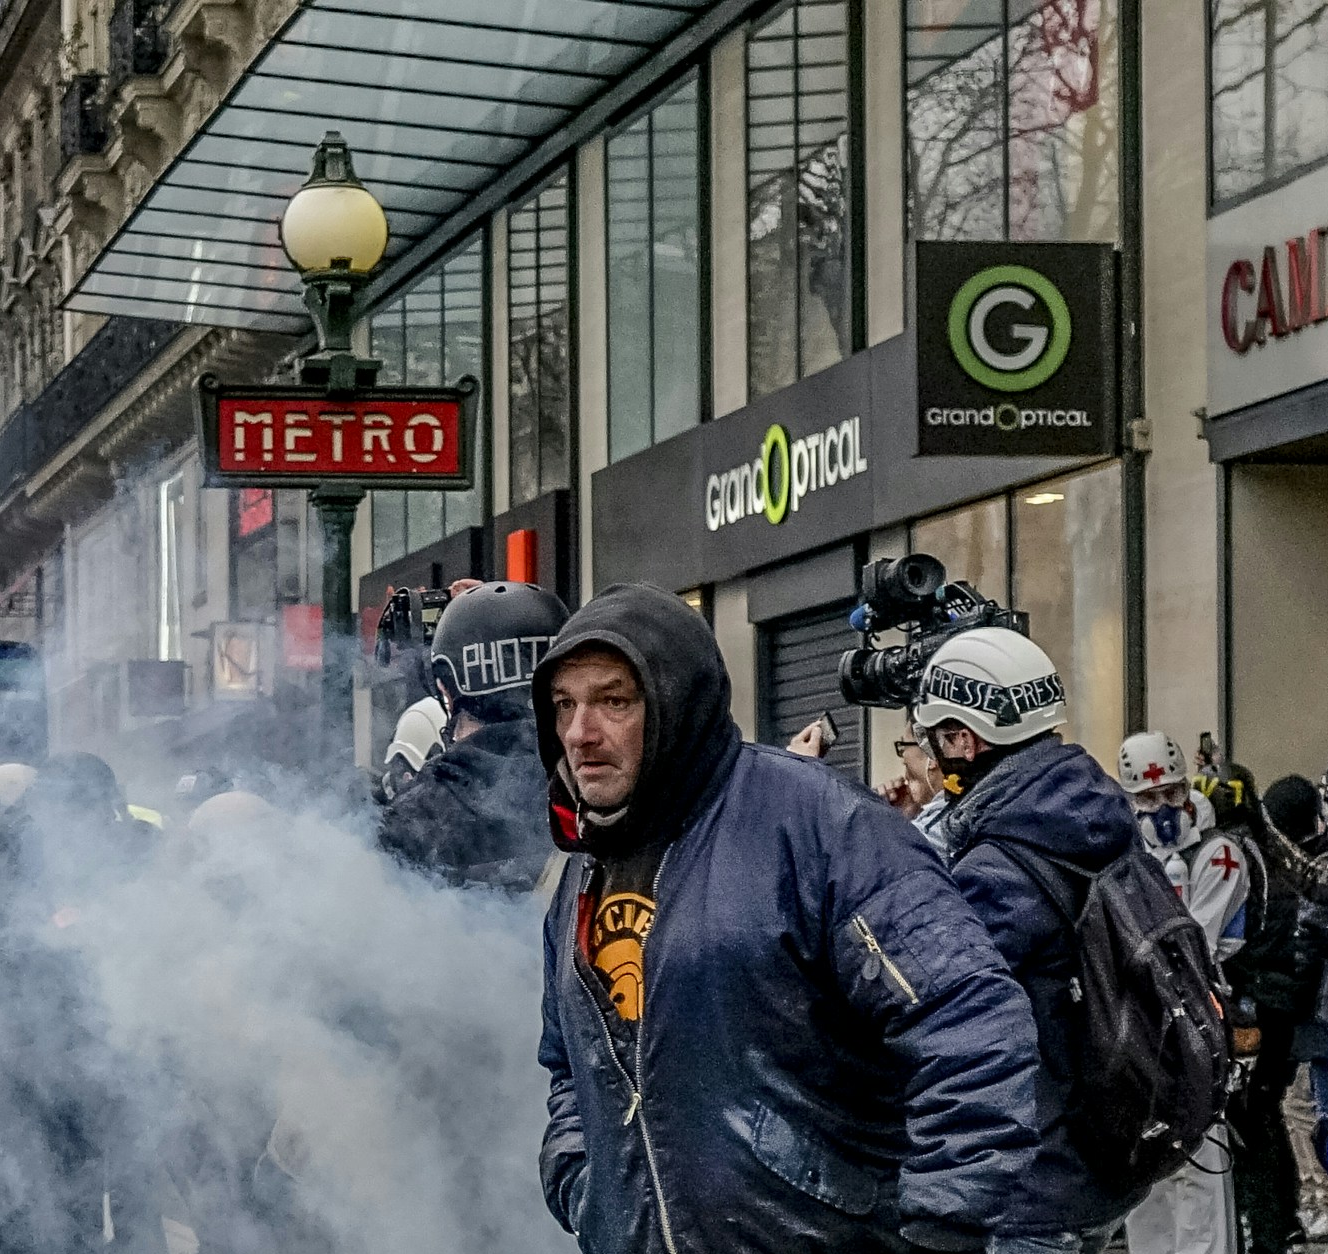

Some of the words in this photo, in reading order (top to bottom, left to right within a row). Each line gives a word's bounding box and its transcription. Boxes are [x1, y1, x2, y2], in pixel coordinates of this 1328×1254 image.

[969, 286, 1049, 371] G
[234, 410, 444, 463] METRO
[462, 635, 559, 690] PHOT
[930, 667, 1003, 713] PRESSE
[1009, 675, 1065, 714] PRESS
